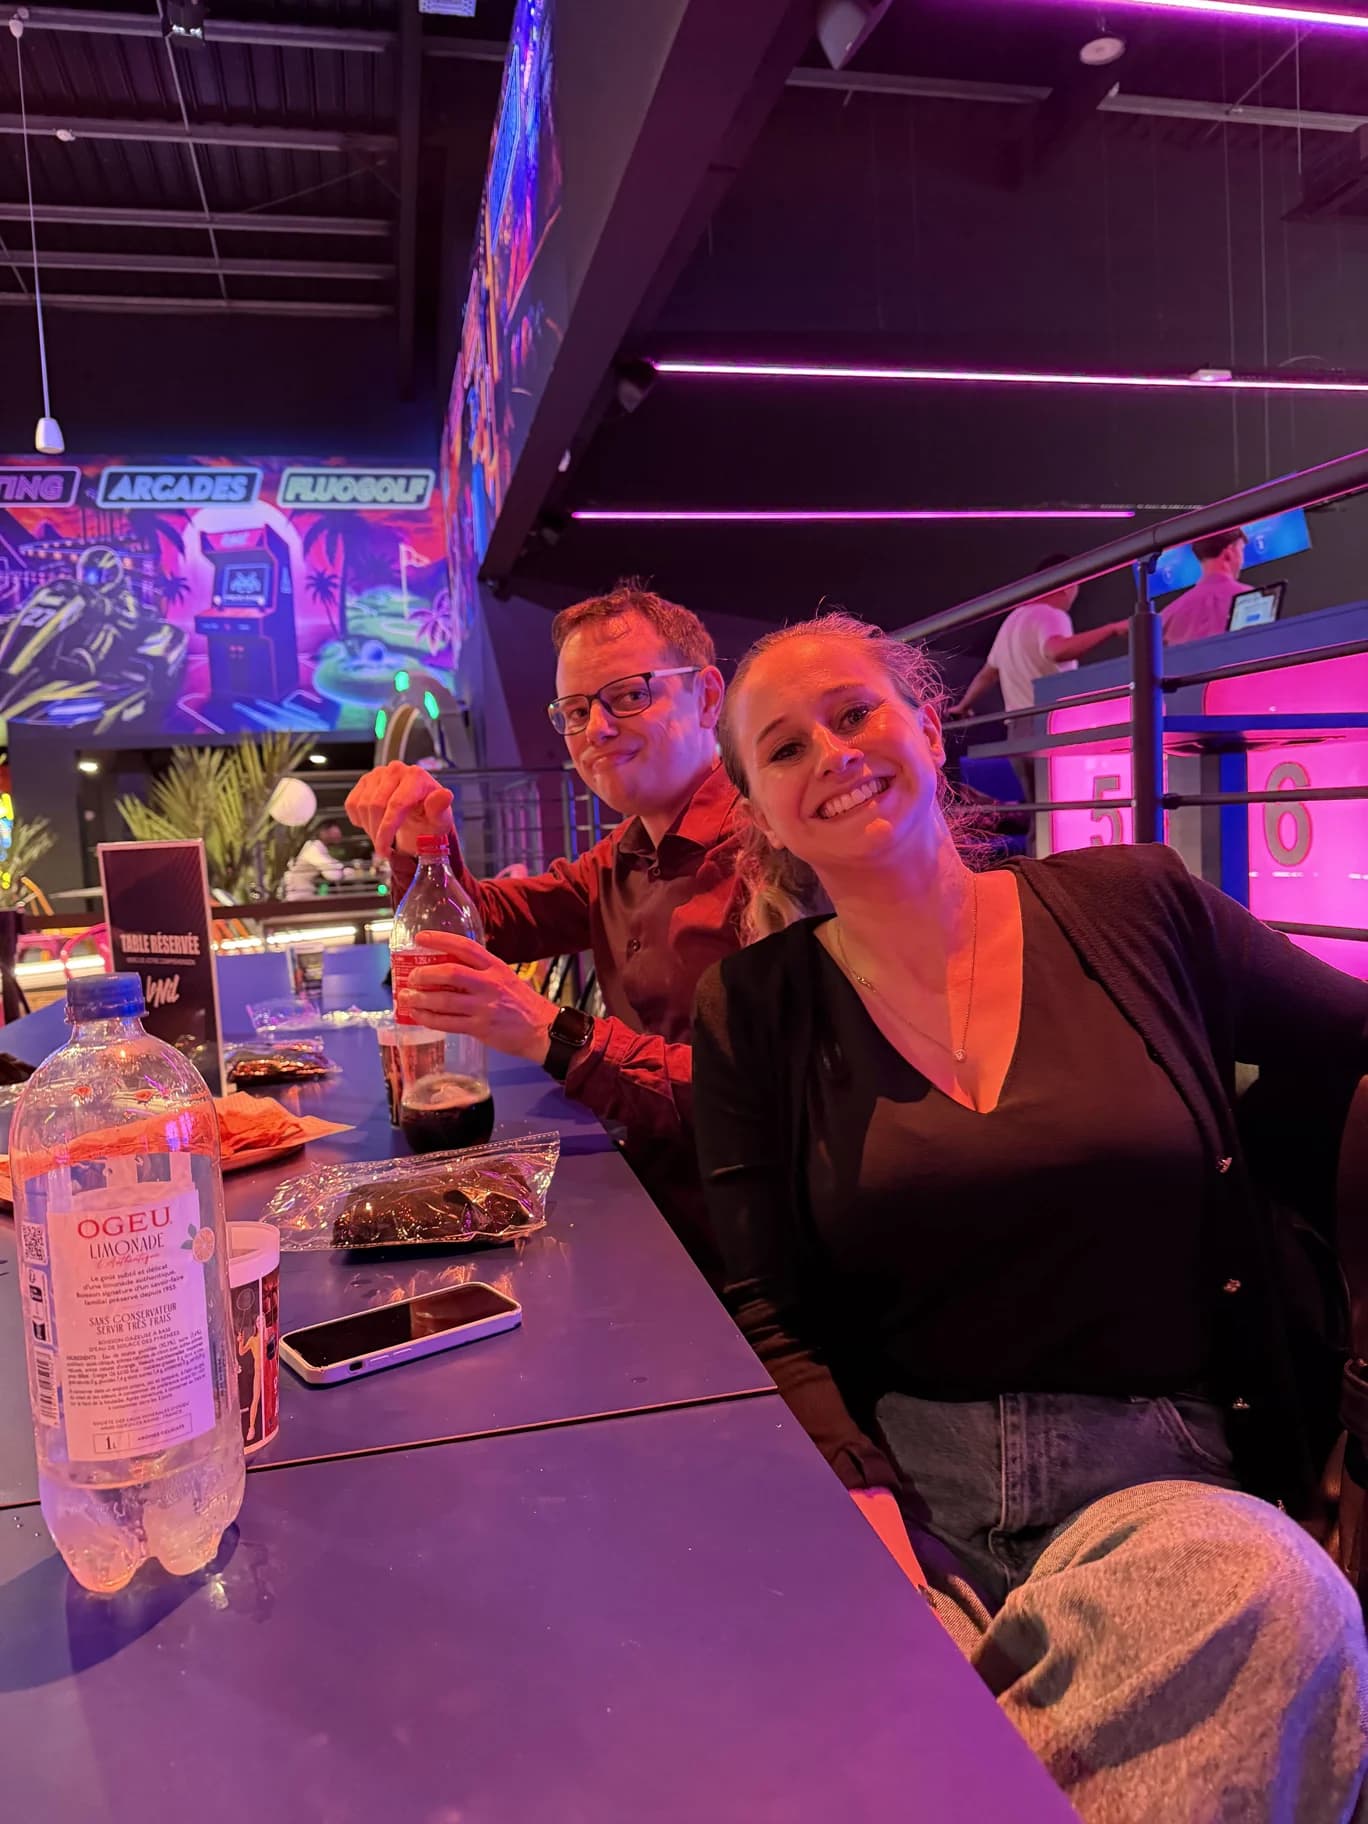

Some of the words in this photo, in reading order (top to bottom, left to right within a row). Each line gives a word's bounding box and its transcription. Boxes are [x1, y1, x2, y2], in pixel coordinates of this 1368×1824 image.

[107, 474, 249, 501] ARCADES
[285, 476, 427, 502] FLUOGOLF
[1090, 775, 1124, 846] 5
[1263, 761, 1313, 867] 6
[120, 933, 150, 954] TABLE
[150, 932, 201, 956] RÉSERVÉE
[77, 1206, 170, 1239] OGEU
[89, 1232, 165, 1260] LIMONADE
[89, 1316, 110, 1327] SANS
[112, 1302, 177, 1324] CONSERVATEUR
[96, 1323, 123, 1336] SERVIR
[149, 1313, 172, 1327] FRAIS
